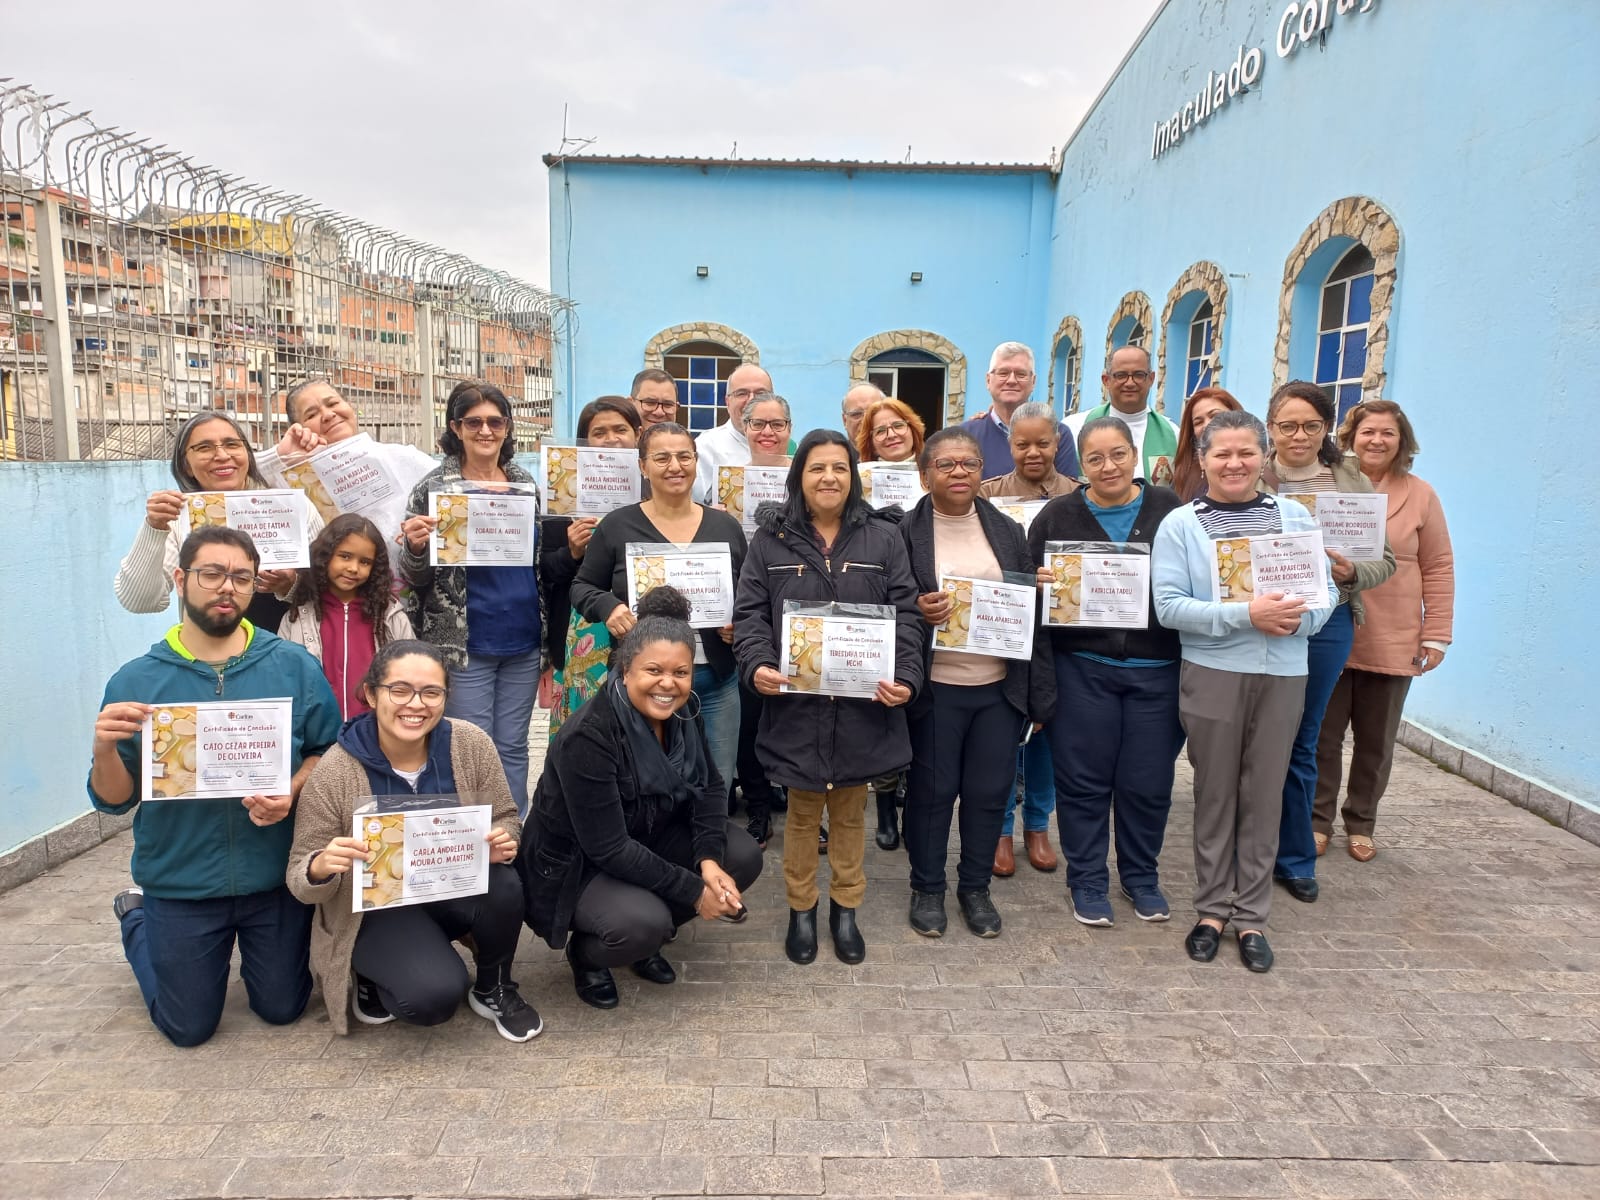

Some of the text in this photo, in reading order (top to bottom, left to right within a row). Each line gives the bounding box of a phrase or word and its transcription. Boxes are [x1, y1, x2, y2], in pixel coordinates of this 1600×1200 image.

[1151, 0, 1373, 160] Imaculado Cor
[1280, 563, 1311, 571] APARECIDA
[1258, 572, 1314, 583] CHAGAS RODRIGUES
[995, 616, 1022, 624] APARECIDA
[203, 740, 276, 751] CAIO CEZAR PEREIRA
[218, 752, 262, 761] DE OLIVEIRA
[412, 830, 440, 838] Certificado
[413, 848, 435, 857] CARLA
[437, 845, 465, 855] ANDREIA
[410, 858, 435, 868] MOURA
[446, 854, 474, 863] MARTINS
